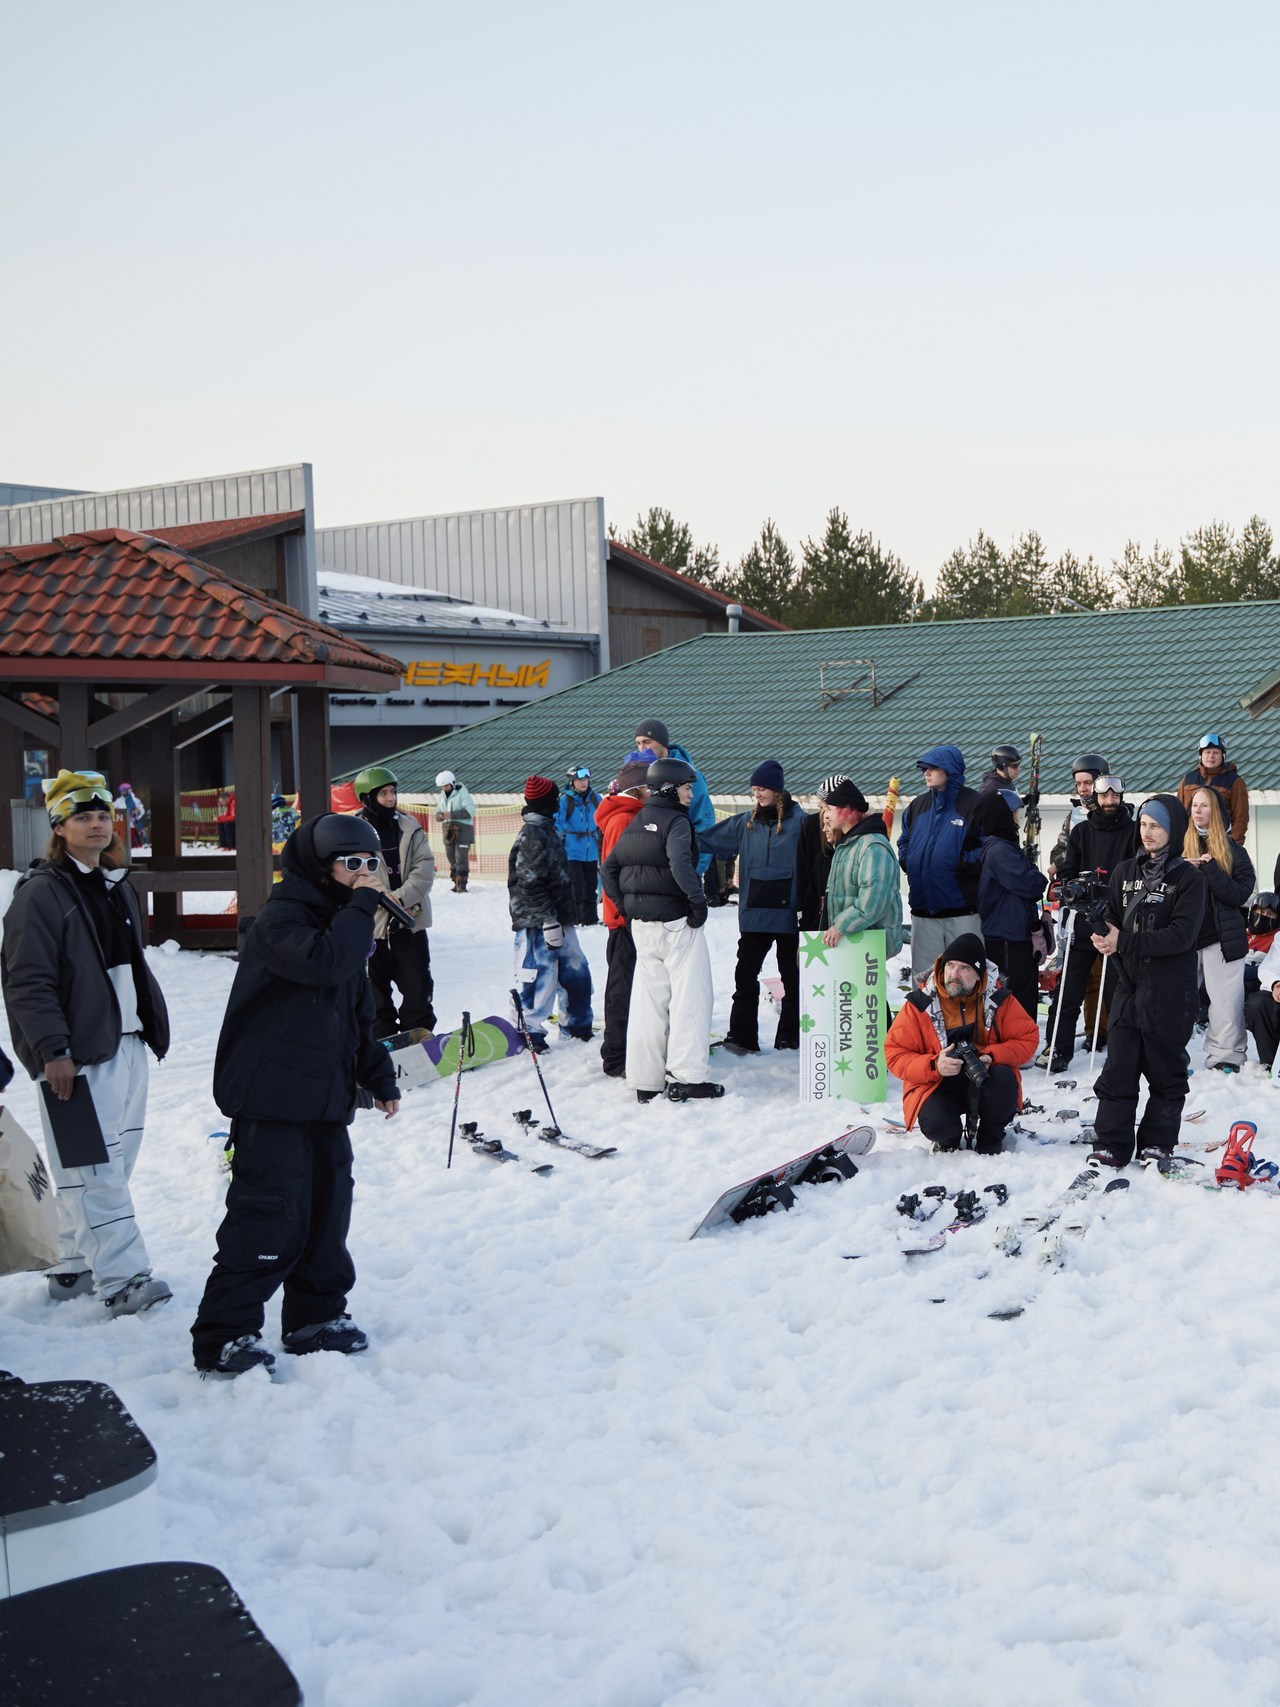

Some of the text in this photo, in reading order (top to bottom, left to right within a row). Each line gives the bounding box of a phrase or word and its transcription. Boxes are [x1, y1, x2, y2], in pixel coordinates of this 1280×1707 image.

[838, 980, 852, 1052] CHUKCHA
[864, 951, 880, 1081] JIB SPRING
